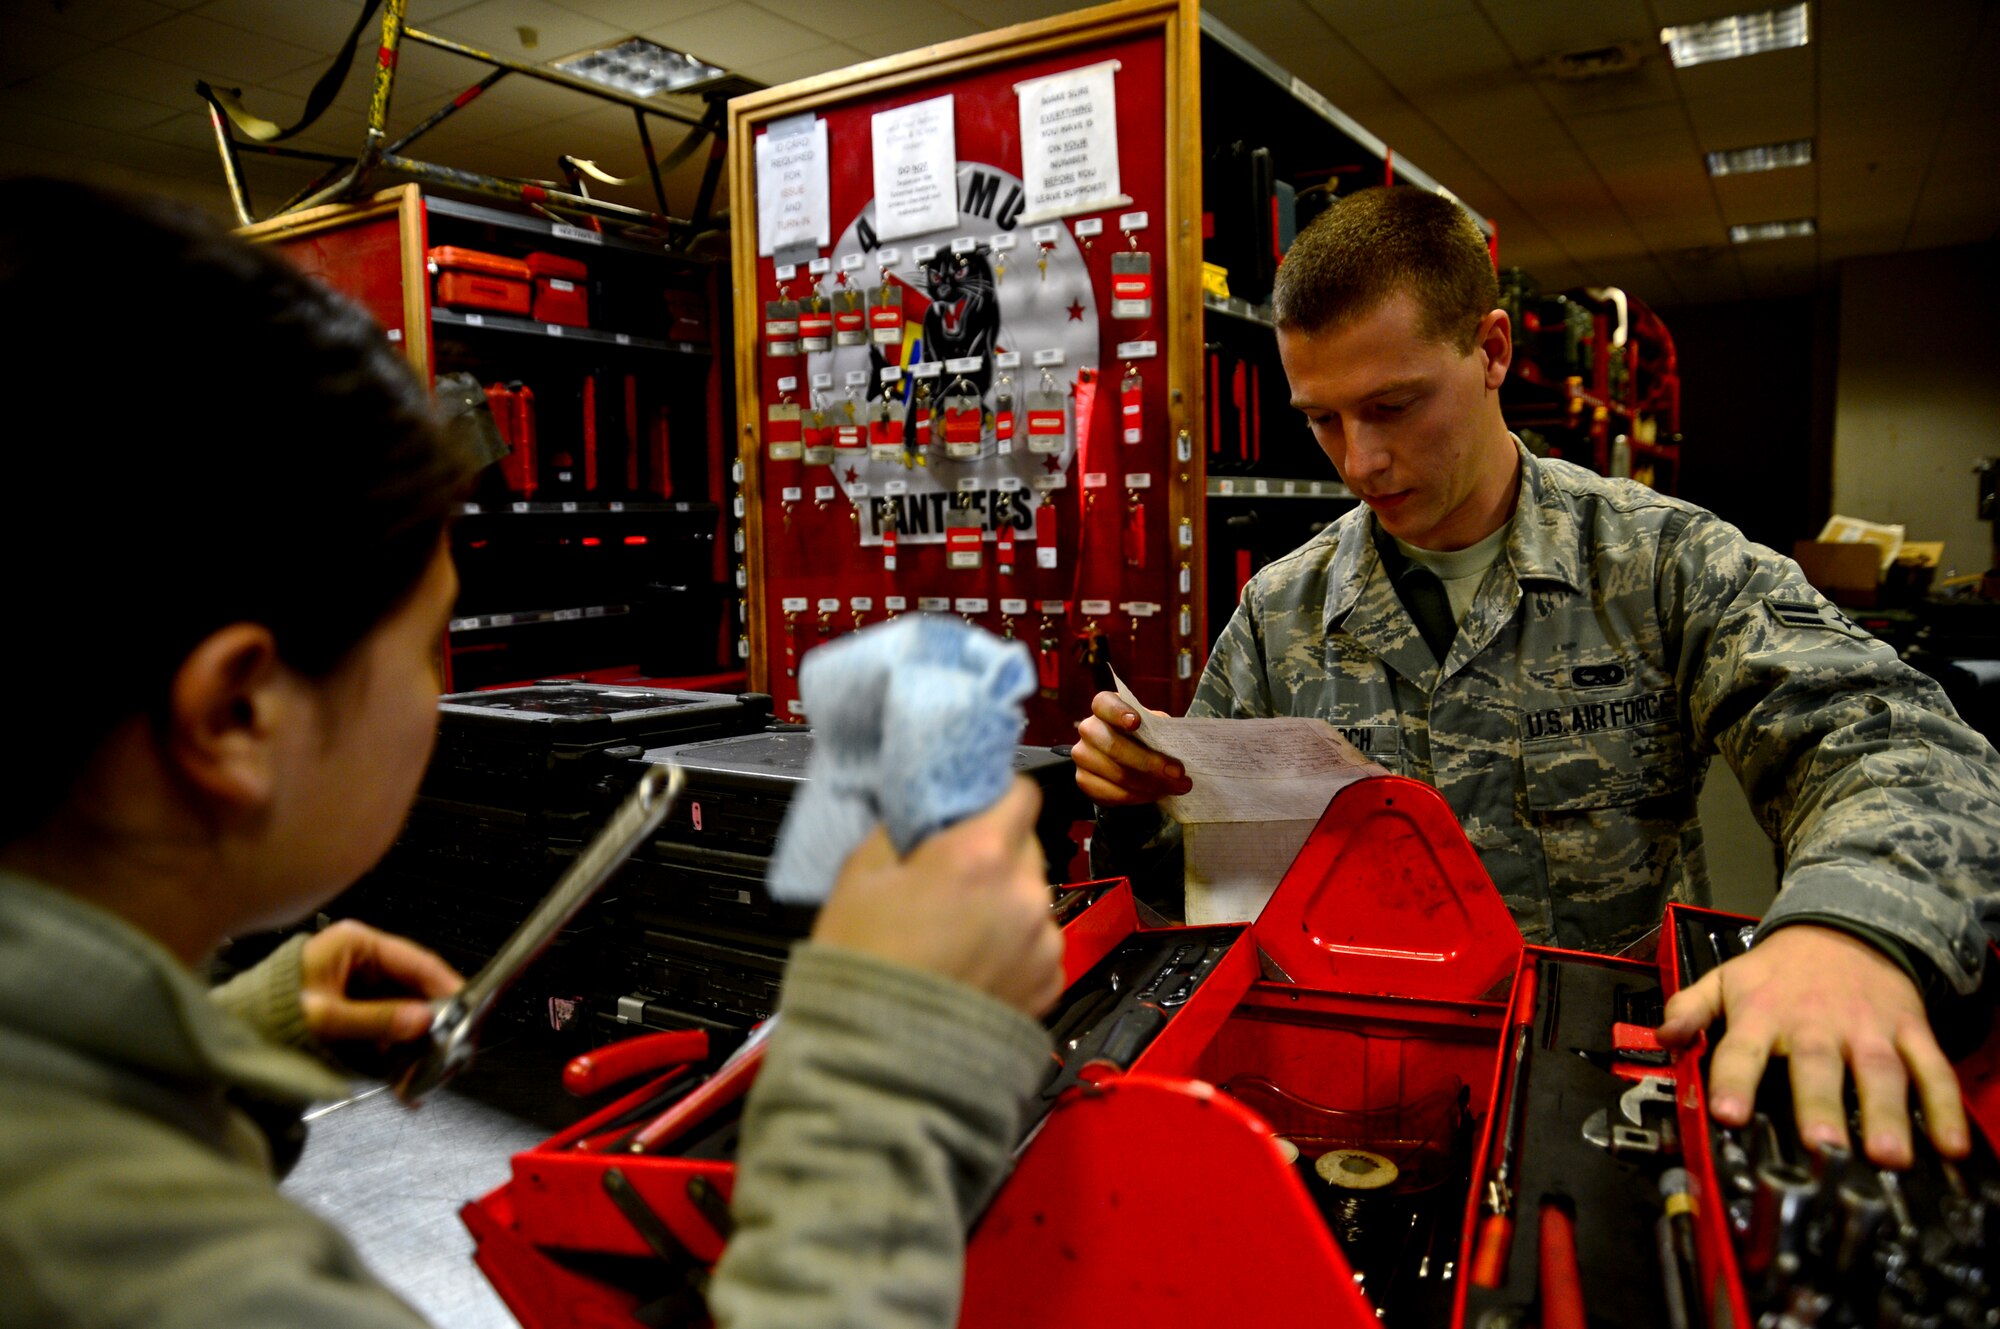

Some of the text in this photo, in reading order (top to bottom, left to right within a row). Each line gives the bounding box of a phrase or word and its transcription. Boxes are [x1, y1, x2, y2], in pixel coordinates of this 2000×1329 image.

[1040, 103, 1093, 122] EVERYTHING
[770, 150, 815, 168] REQUIRED
[1050, 153, 1088, 169] NUMBER
[783, 169, 802, 182] FOR
[1044, 173, 1075, 187] BEFORE
[781, 185, 806, 198] ISSUE
[784, 201, 802, 213] AND
[1526, 693, 1674, 737] U.S. AIR FORCE
